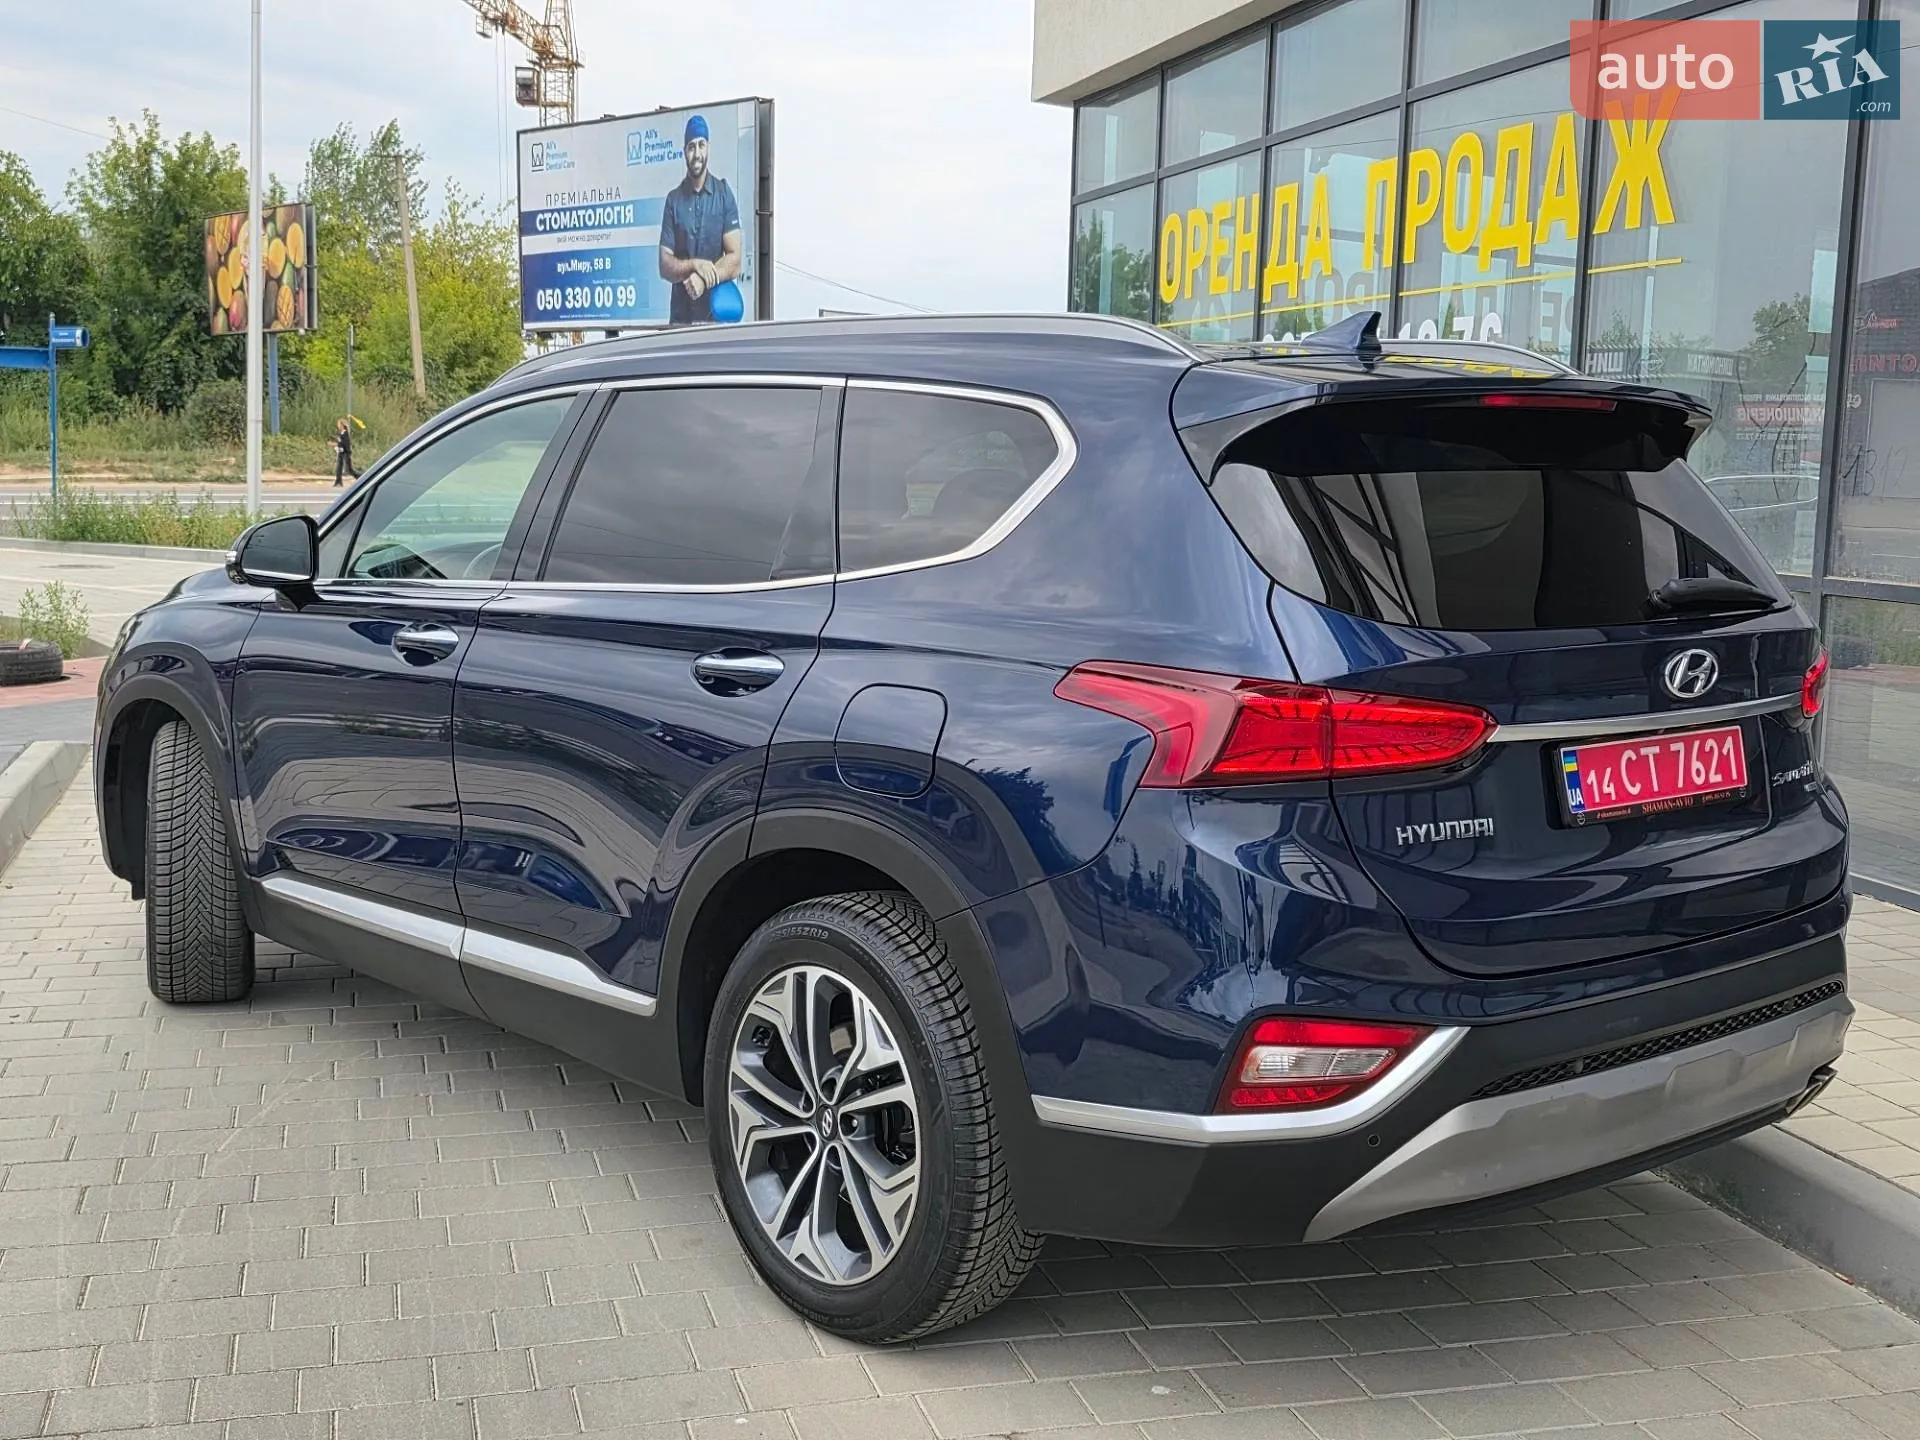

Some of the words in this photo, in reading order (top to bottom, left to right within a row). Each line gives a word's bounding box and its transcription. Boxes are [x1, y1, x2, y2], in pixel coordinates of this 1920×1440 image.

[644, 140, 673, 150] Premium
[644, 153, 666, 165] Dental
[667, 150, 683, 161] Care
[545, 186, 622, 207] ПРЕМІАЛЬНА
[535, 203, 635, 232] СТОМАТОЛОГІЯ
[1159, 174, 1333, 304] ОРЕНДА
[536, 287, 562, 311] 050
[565, 286, 591, 309] 330
[594, 284, 613, 308] 00
[617, 284, 636, 307] 99
[1586, 767, 1616, 804] 14
[1669, 735, 1737, 789] 7621
[1568, 788, 1585, 806] UA
[1395, 817, 1494, 846] HYUNDAI
